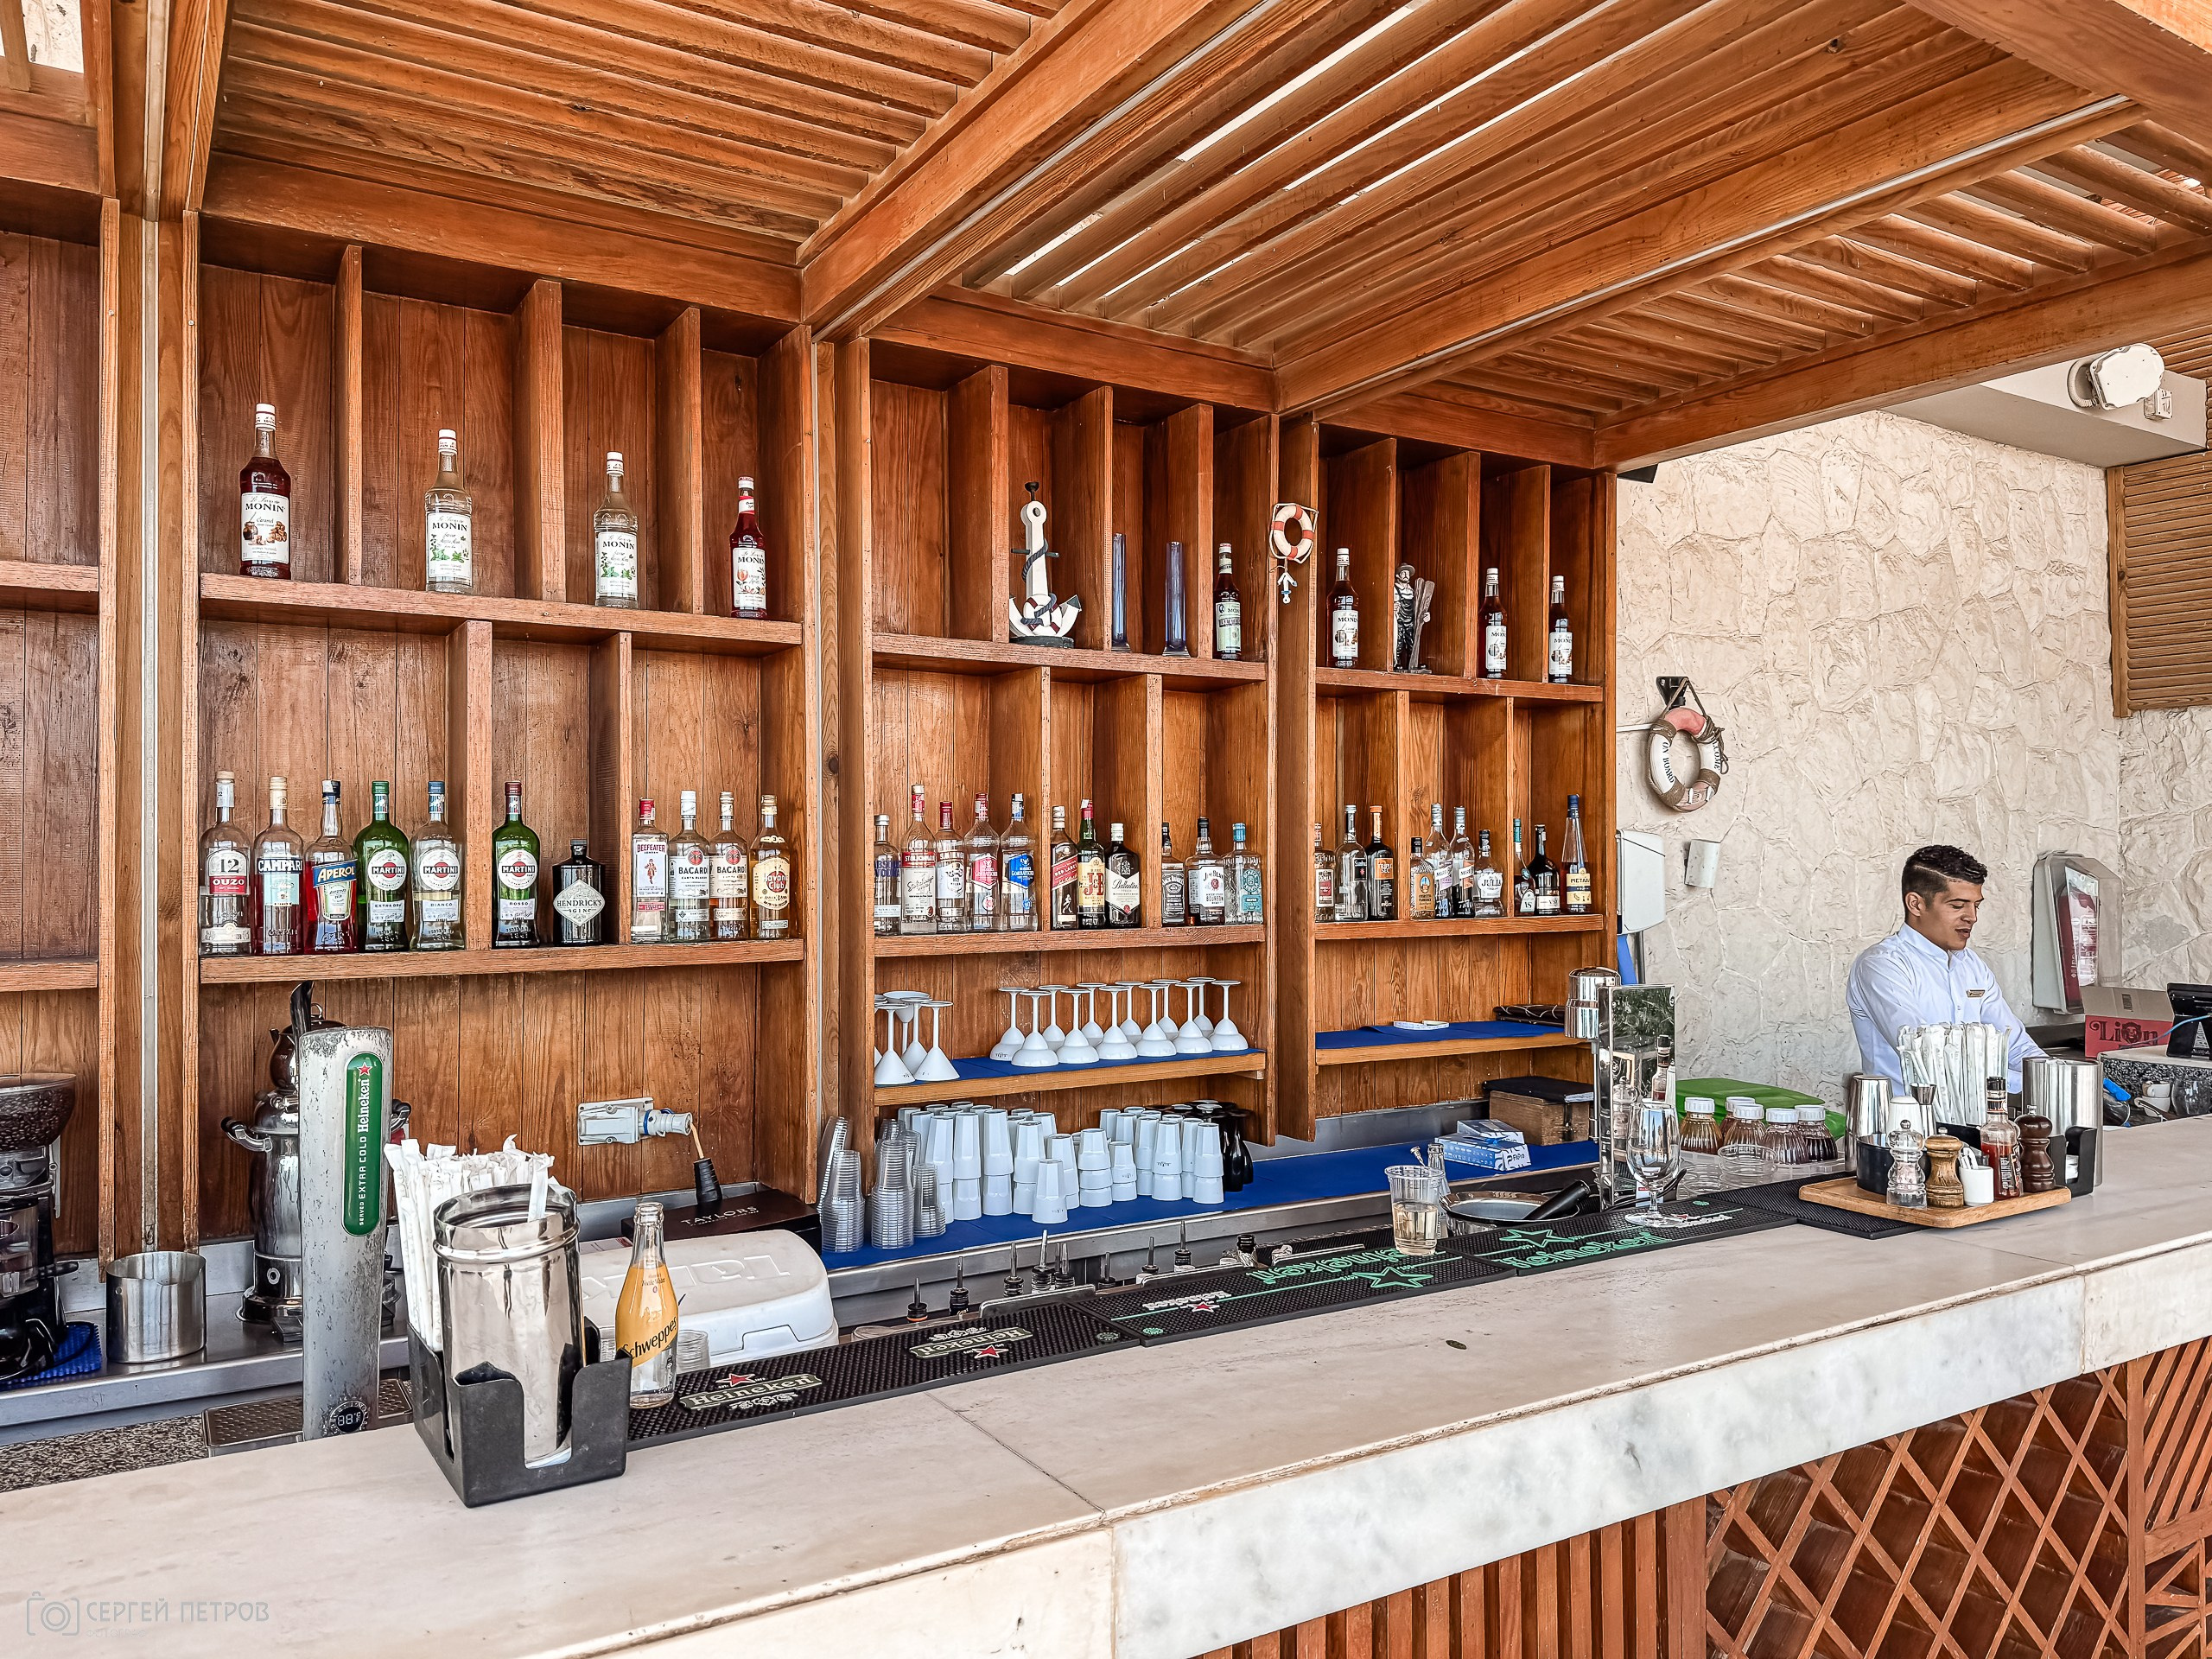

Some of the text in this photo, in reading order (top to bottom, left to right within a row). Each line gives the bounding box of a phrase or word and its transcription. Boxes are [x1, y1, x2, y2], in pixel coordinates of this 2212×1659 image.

[245, 503, 284, 512] MONIN
[432, 522, 467, 531] MONIN
[603, 541, 634, 550] MONIN
[1662, 741, 1675, 783] ON BOARD
[637, 844, 665, 853] BEEFEATER
[220, 859, 239, 873] 12
[258, 859, 302, 872] CAMPARI
[318, 866, 354, 883] APEROL
[769, 881, 785, 890] Club
[556, 899, 602, 907] HENDRICK'S
[358, 1078, 370, 1134] Heineken
[681, 1206, 757, 1224] TAYLORS
[918, 1329, 1025, 1355] Heineken
[690, 1376, 814, 1406] Heineken
